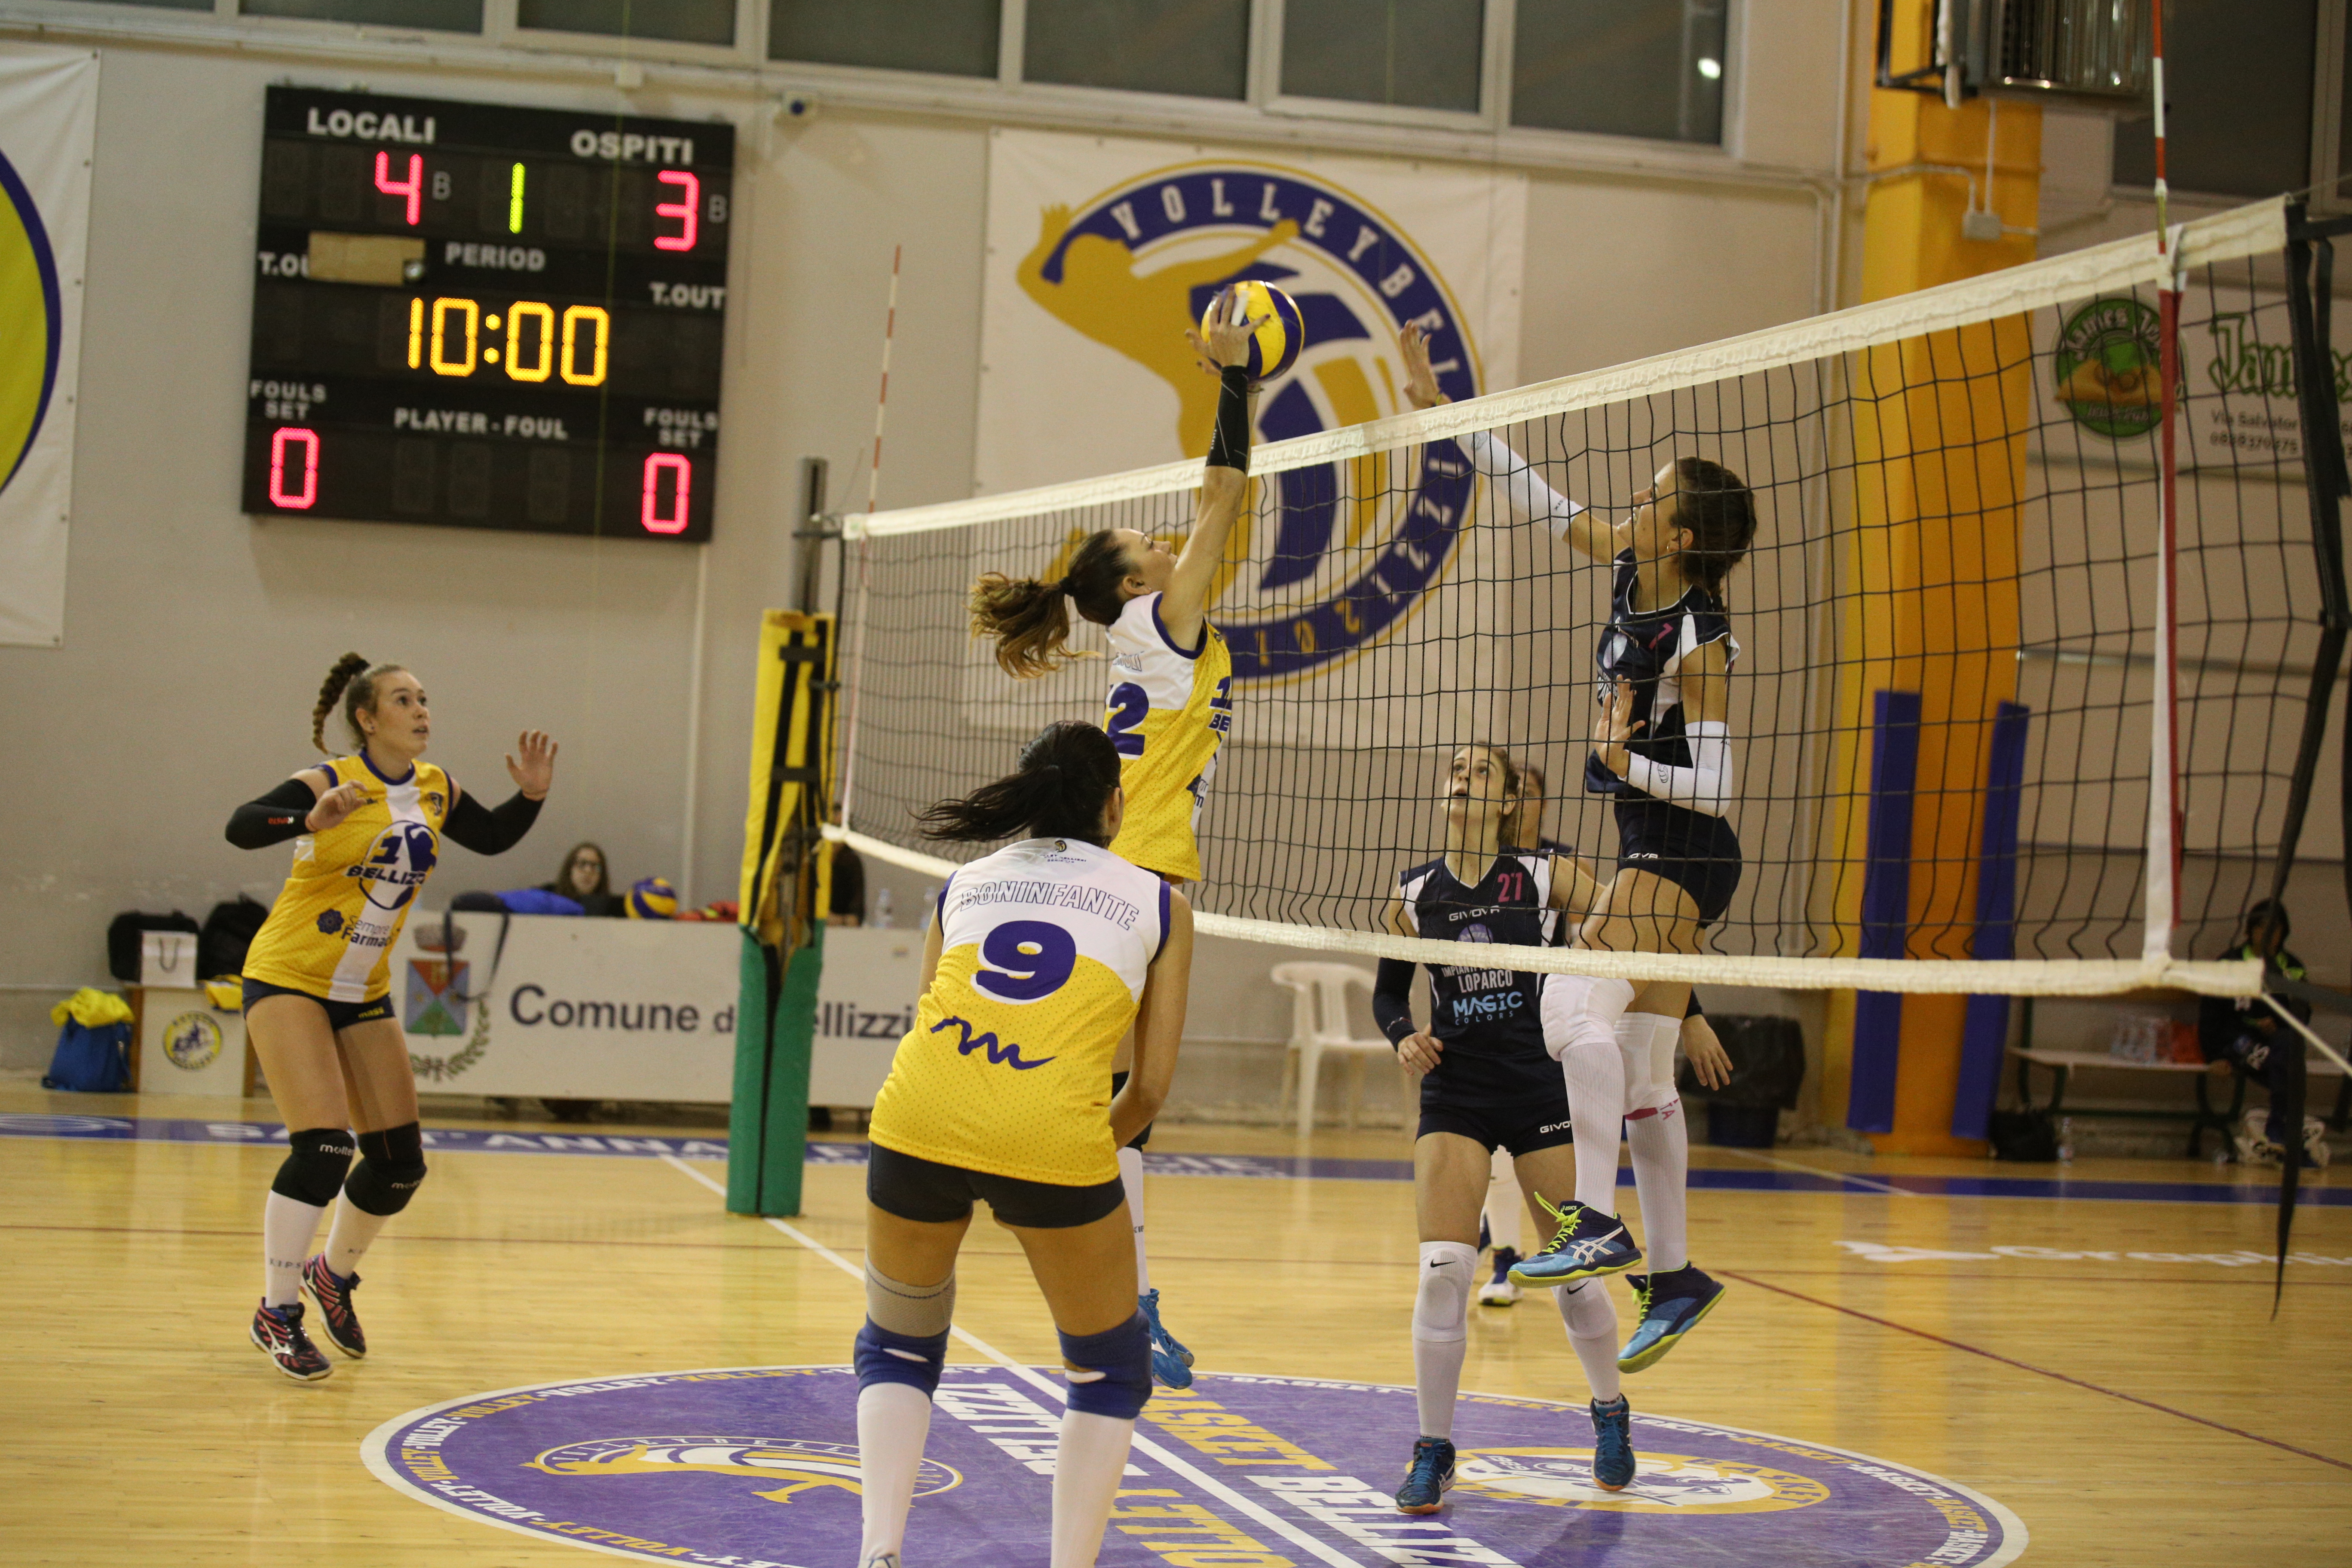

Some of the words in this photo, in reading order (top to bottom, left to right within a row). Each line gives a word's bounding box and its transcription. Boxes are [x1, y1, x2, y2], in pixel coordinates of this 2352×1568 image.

[307, 107, 435, 144] LOCALI
[571, 130, 693, 164] OSPITI
[375, 151, 423, 225] 4
[509, 162, 526, 233] 1
[654, 170, 699, 251] 3
[445, 241, 545, 272] PERIOD
[650, 282, 726, 309] T.OUT
[409, 297, 609, 386] 10:00
[250, 380, 327, 403] FOULS
[265, 399, 310, 420] SET
[644, 408, 719, 430] FOULS
[658, 427, 703, 449] SET
[270, 428, 319, 509] 0
[641, 452, 690, 533] 0
[960, 881, 1139, 931] BONINFANTE
[975, 920, 1077, 1001] 9
[1458, 969, 1513, 993] LOPARCO
[509, 983, 701, 1033] Comune
[815, 1002, 913, 1039] llizzi
[1453, 991, 1523, 1018] MAGIC
[1455, 1010, 1513, 1026] COLORS
[1540, 1120, 1571, 1133] GIVO
